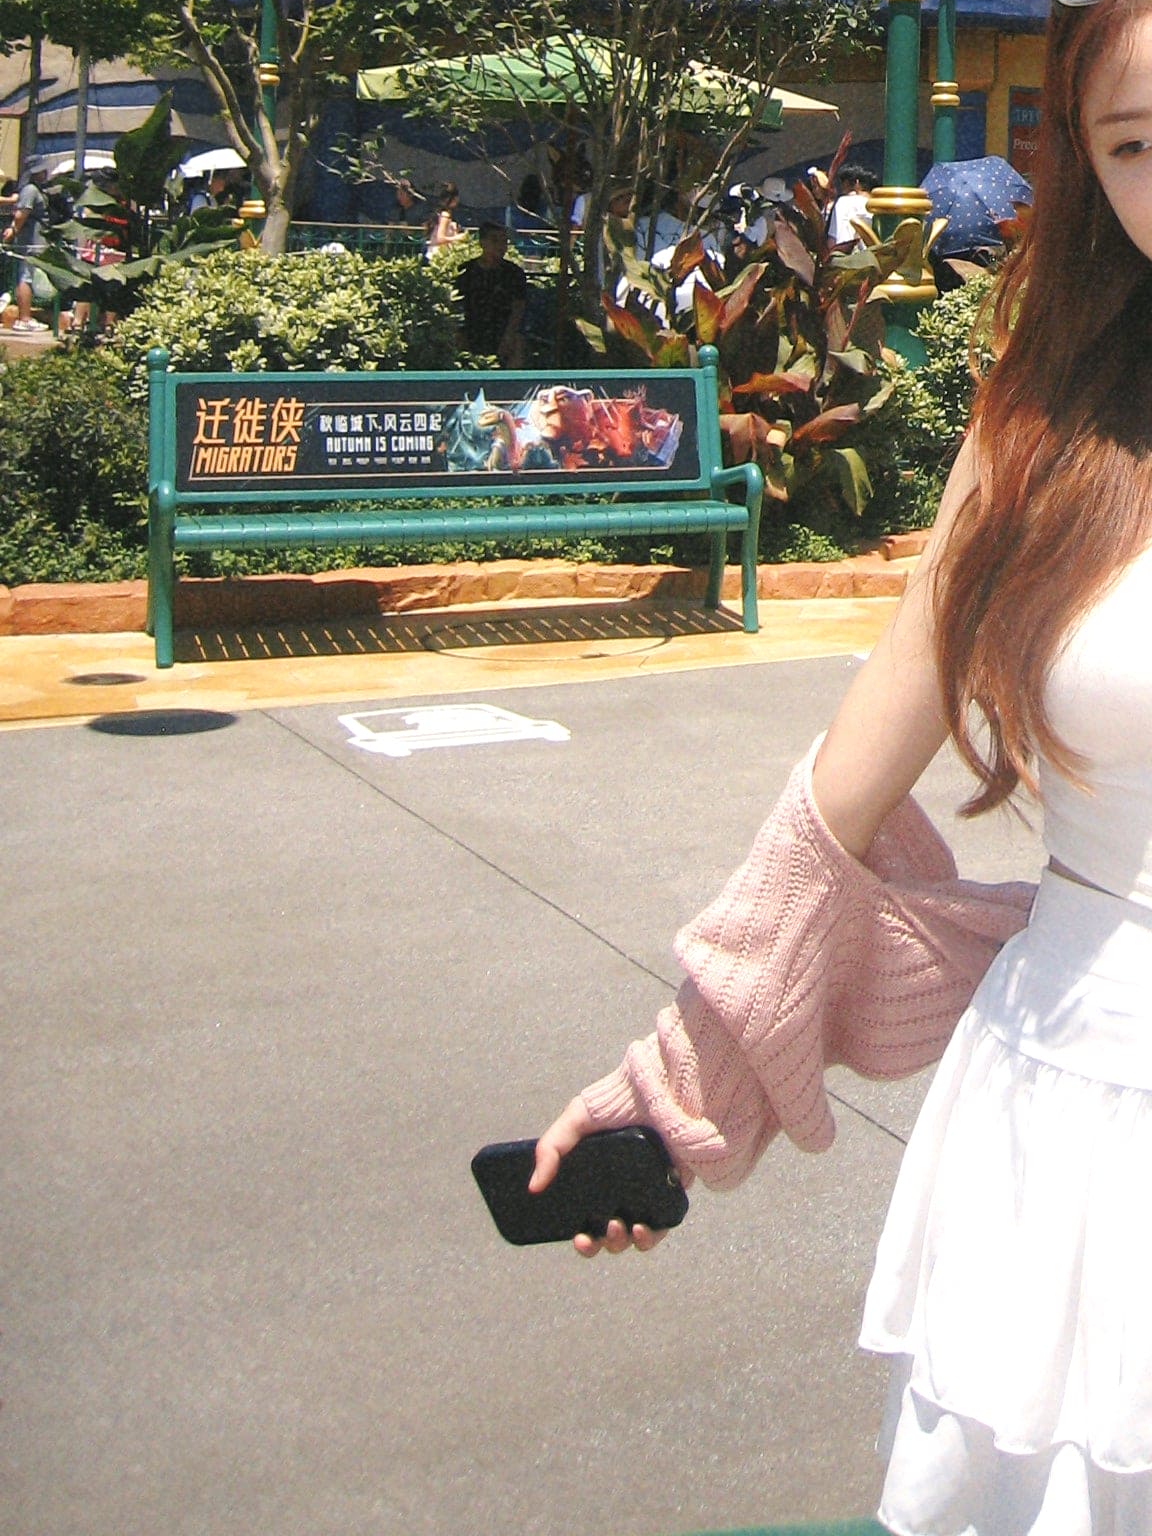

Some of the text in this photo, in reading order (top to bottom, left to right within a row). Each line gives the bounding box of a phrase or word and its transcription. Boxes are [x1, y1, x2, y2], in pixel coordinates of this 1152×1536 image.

[193, 397, 306, 444] 迁徙侠
[326, 435, 434, 453] AUTUMN IS COMING
[195, 445, 299, 474] MIGRATORS
